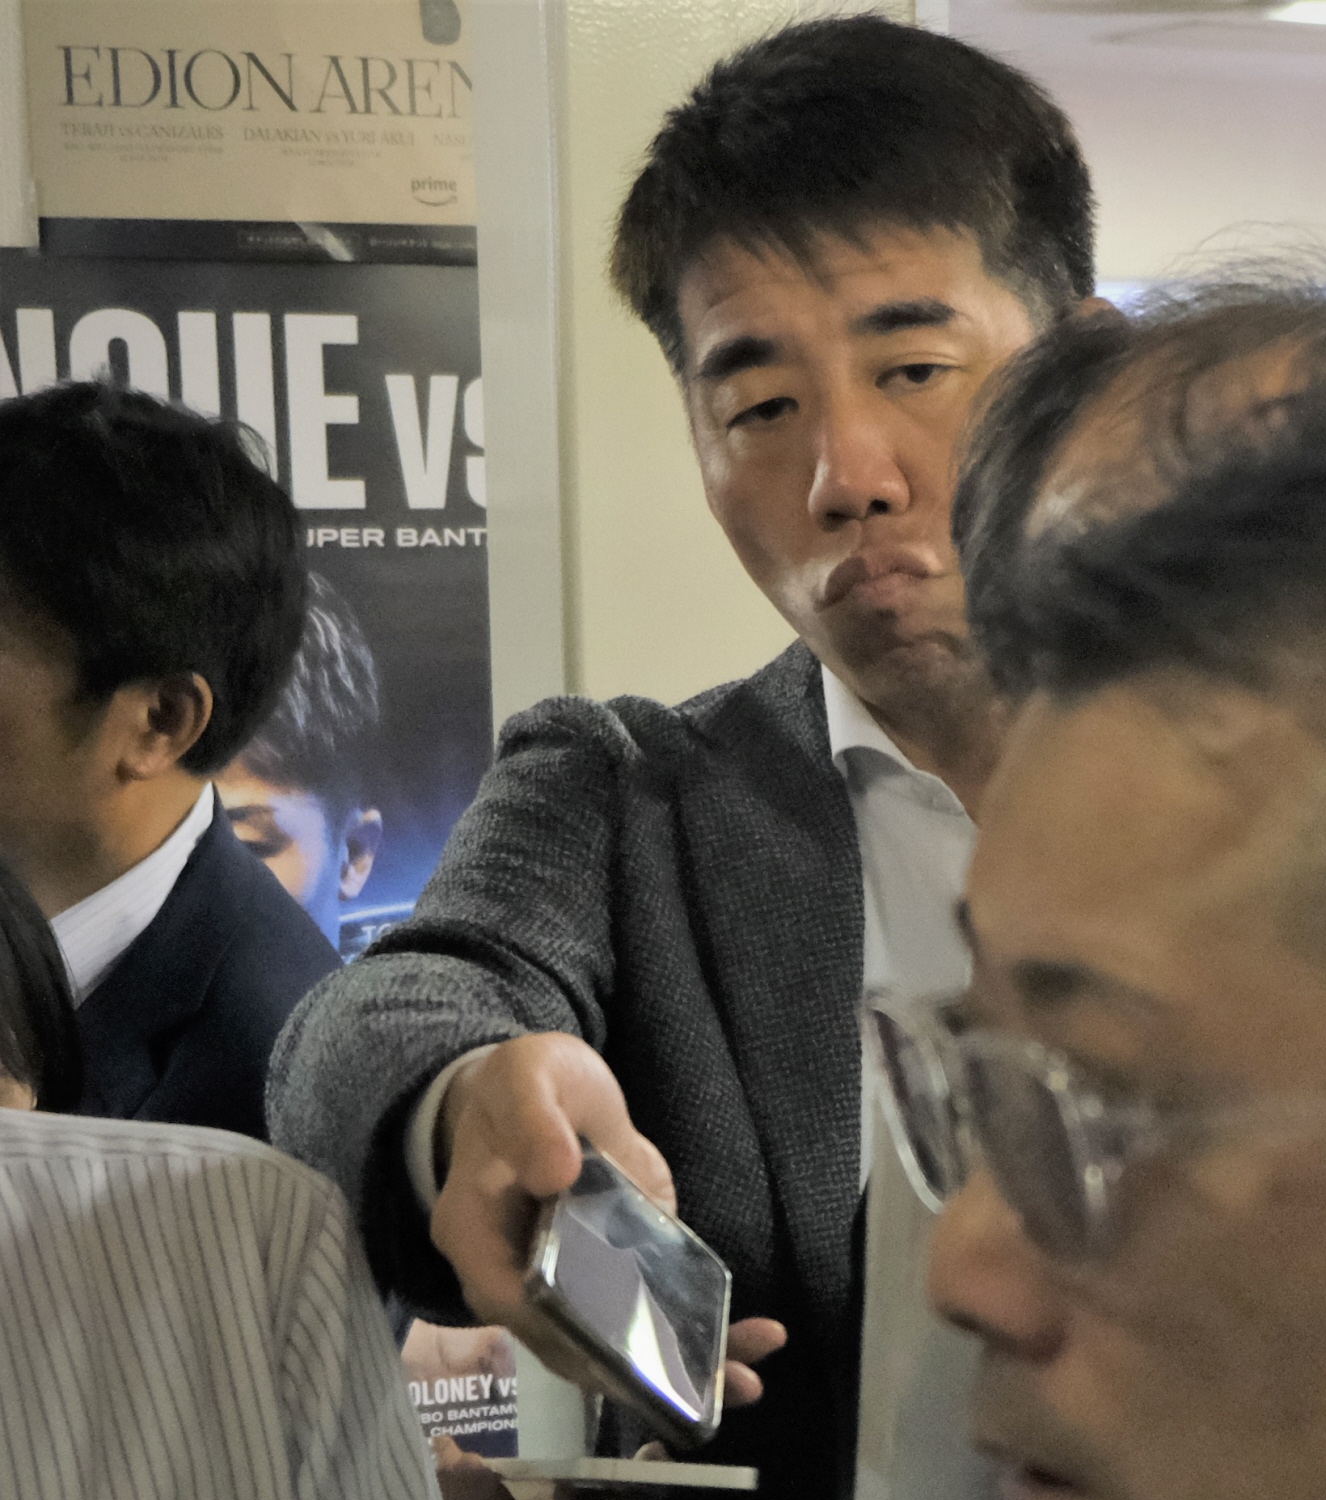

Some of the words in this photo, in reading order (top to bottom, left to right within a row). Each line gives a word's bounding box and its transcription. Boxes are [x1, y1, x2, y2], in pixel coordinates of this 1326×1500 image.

[56, 44, 298, 113] EDION
[308, 54, 472, 118] AREN
[411, 176, 457, 193] prime
[396, 527, 488, 548] BANT
[447, 1402, 518, 1421] BANTAM
[429, 1418, 518, 1438] CHAMPION
